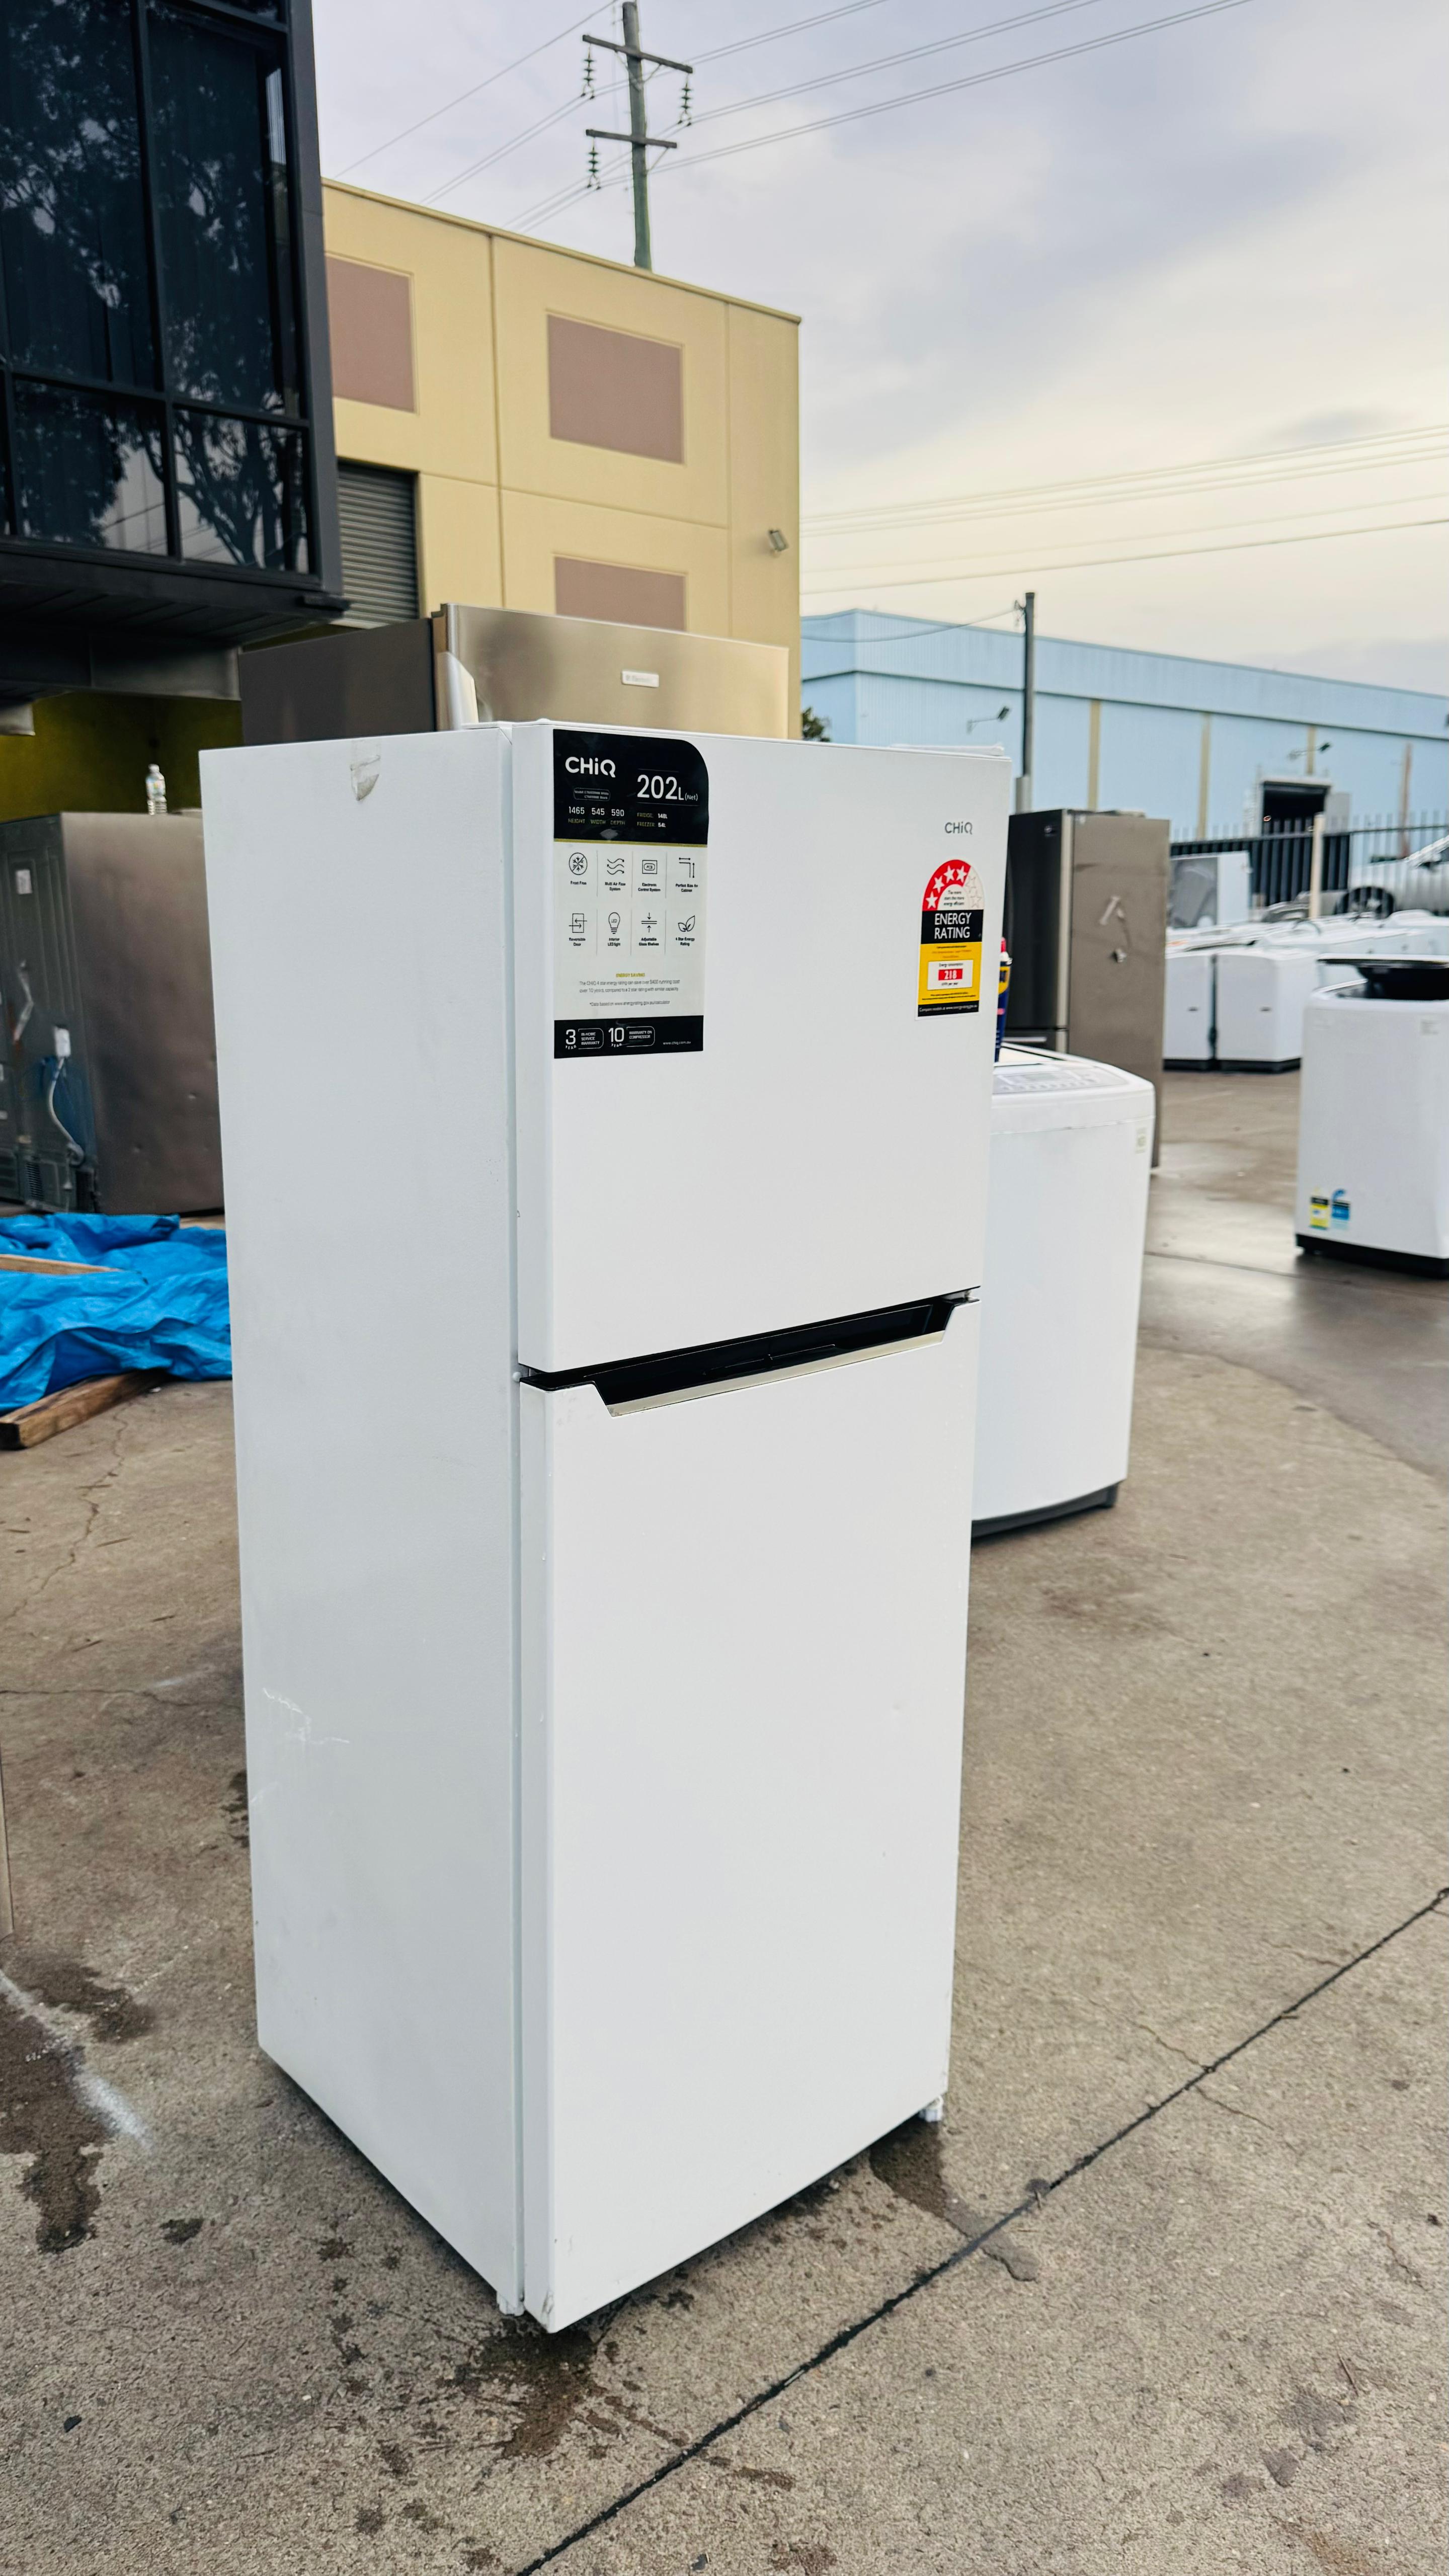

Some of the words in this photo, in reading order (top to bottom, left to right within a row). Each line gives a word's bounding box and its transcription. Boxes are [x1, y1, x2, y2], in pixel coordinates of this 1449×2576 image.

[565, 756, 616, 778] CHiQ
[569, 806, 585, 815] 1465
[611, 809, 624, 817] 590
[945, 821, 973, 835] CHiQ
[934, 912, 972, 925] ENERGY
[934, 926, 971, 939] RATING
[944, 970, 957, 980] 218
[566, 1029, 576, 1045] 3
[608, 1027, 624, 1042] 10
